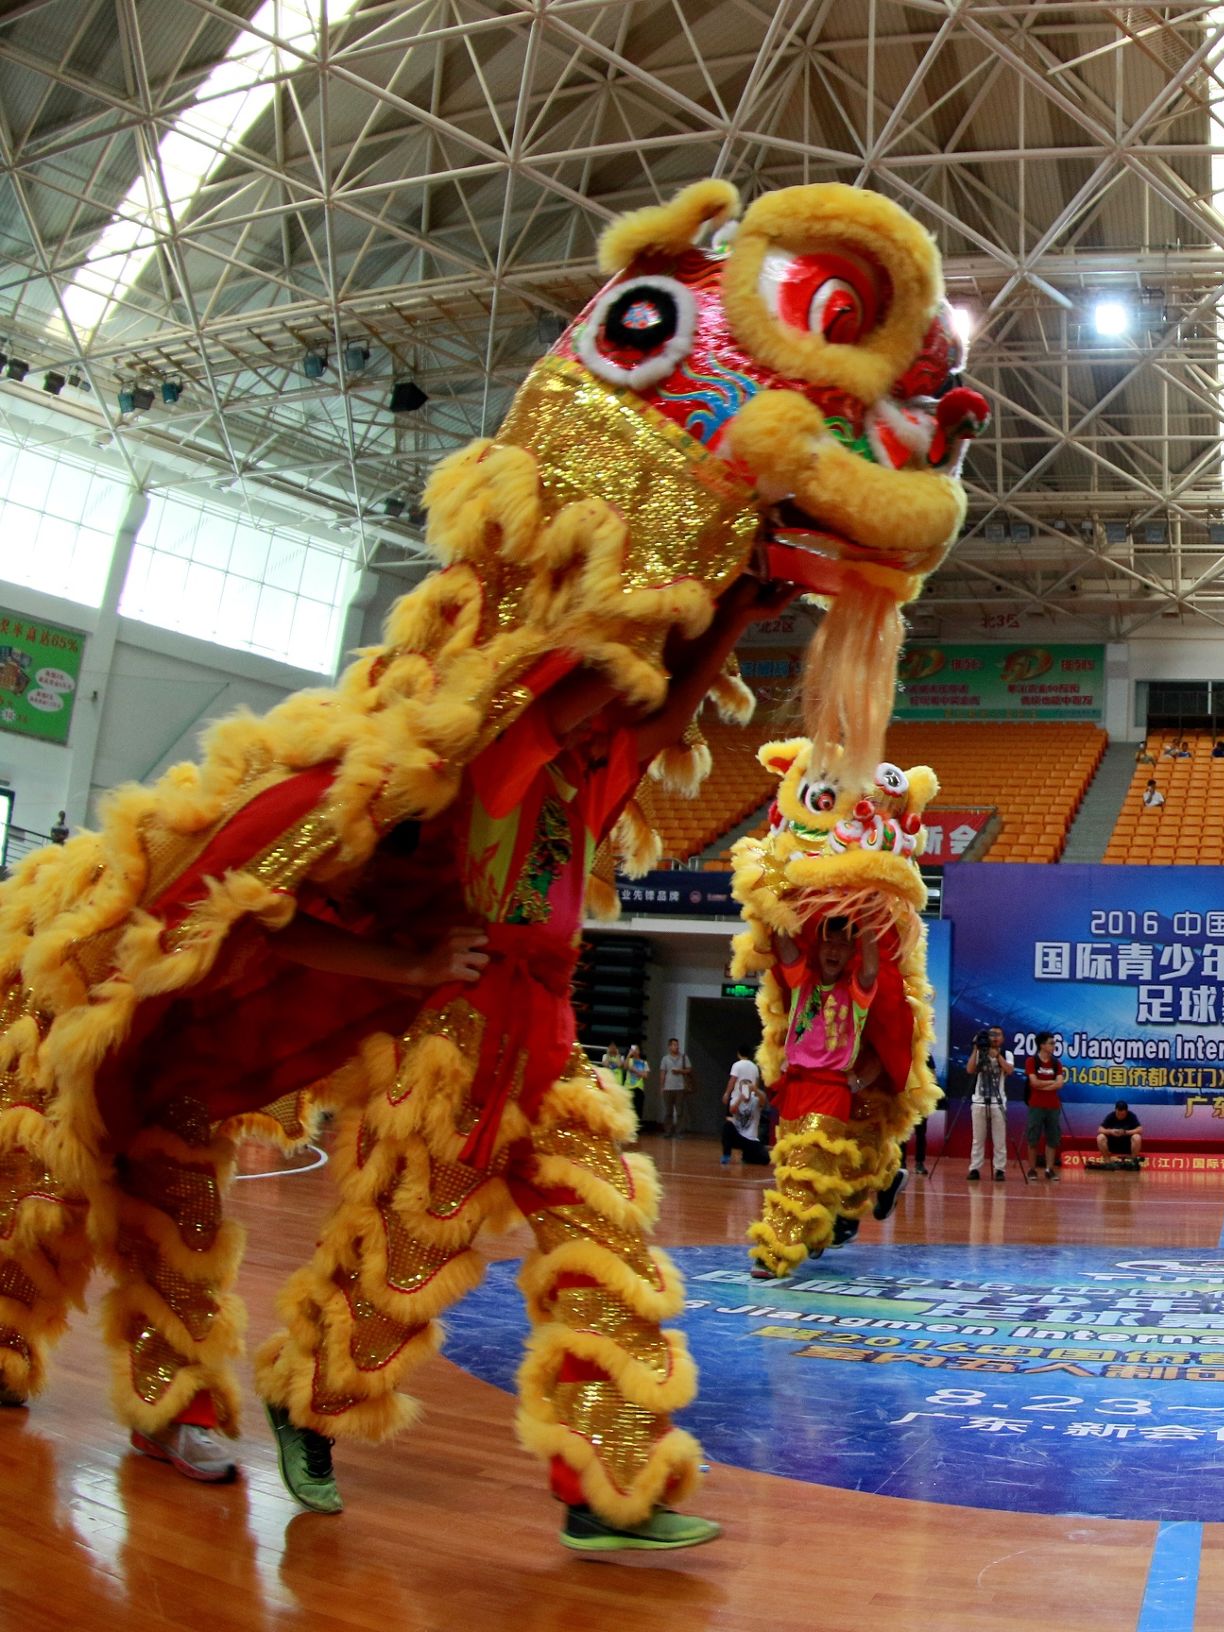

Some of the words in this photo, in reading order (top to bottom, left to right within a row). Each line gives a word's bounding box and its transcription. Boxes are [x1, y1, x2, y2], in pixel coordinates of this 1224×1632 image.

[617, 890, 680, 902] 业先锋品牌
[1091, 910, 1159, 935] 2016
[1013, 1034, 1064, 1056] 206
[1068, 1033, 1172, 1064] Jiangmen
[715, 1303, 998, 1336] Jiangmen
